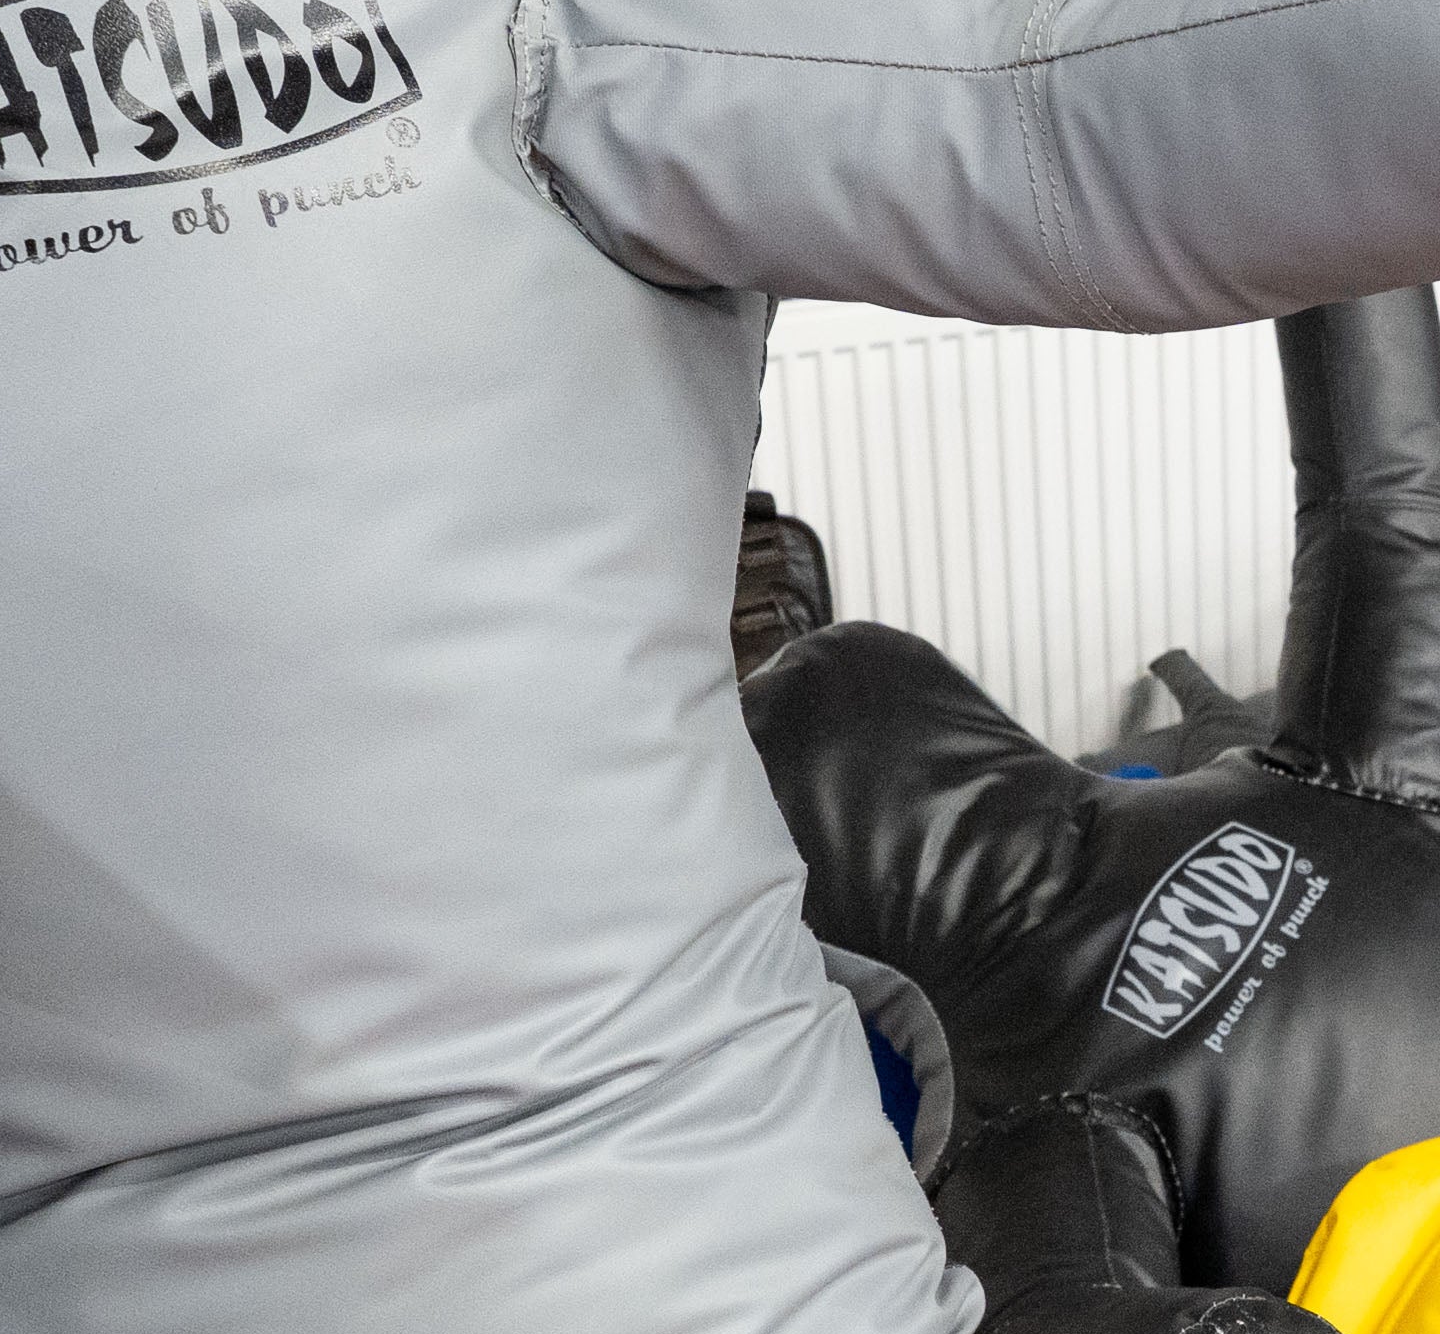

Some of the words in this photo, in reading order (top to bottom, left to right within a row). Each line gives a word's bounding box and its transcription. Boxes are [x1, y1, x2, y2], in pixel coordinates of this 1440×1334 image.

[171, 188, 231, 236] of
[261, 155, 422, 228] punch
[1115, 833, 1283, 1026] KATSUDO
[1203, 976, 1263, 1054] power
[1261, 940, 1287, 969] of
[1280, 875, 1330, 939] punch
